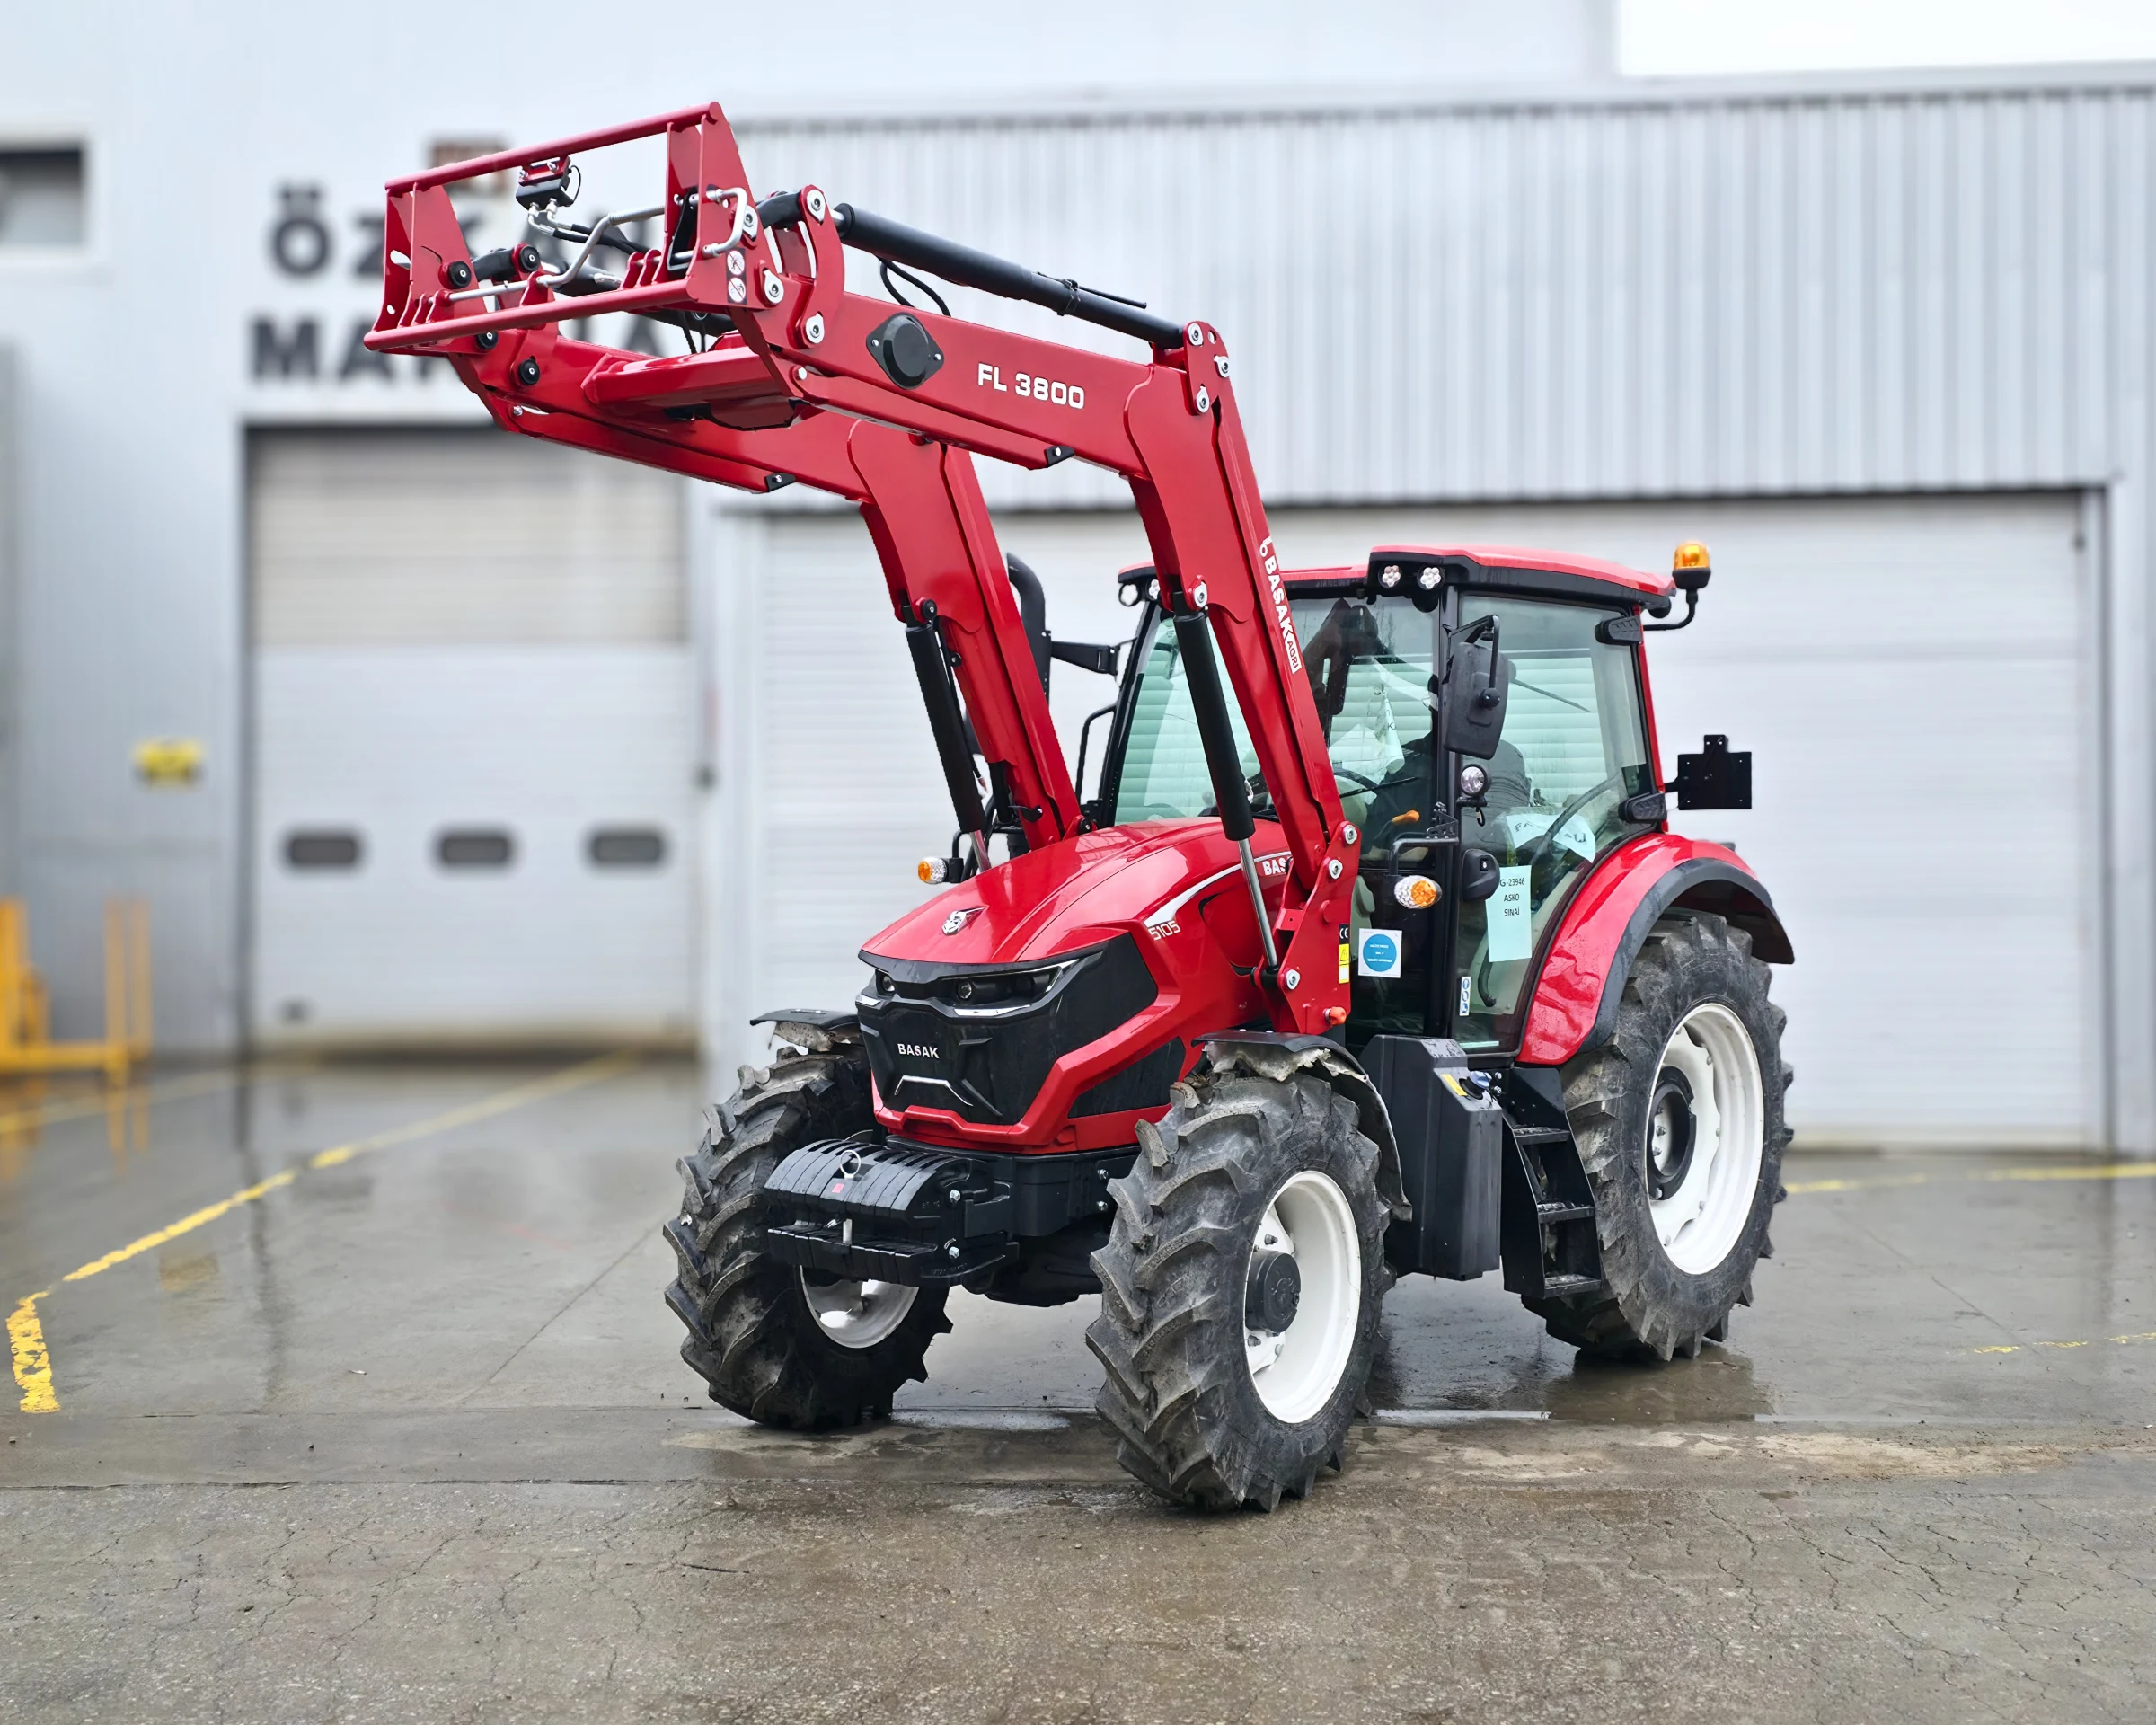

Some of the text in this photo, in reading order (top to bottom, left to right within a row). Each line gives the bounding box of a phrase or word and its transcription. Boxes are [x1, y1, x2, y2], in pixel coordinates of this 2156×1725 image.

[977, 362, 1085, 410] FL 3800
[1264, 555, 1300, 670] BASAK AGRI
[1262, 857, 1287, 876] BAS
[1147, 920, 1181, 941] 5105
[897, 1043, 940, 1059] BASAK
